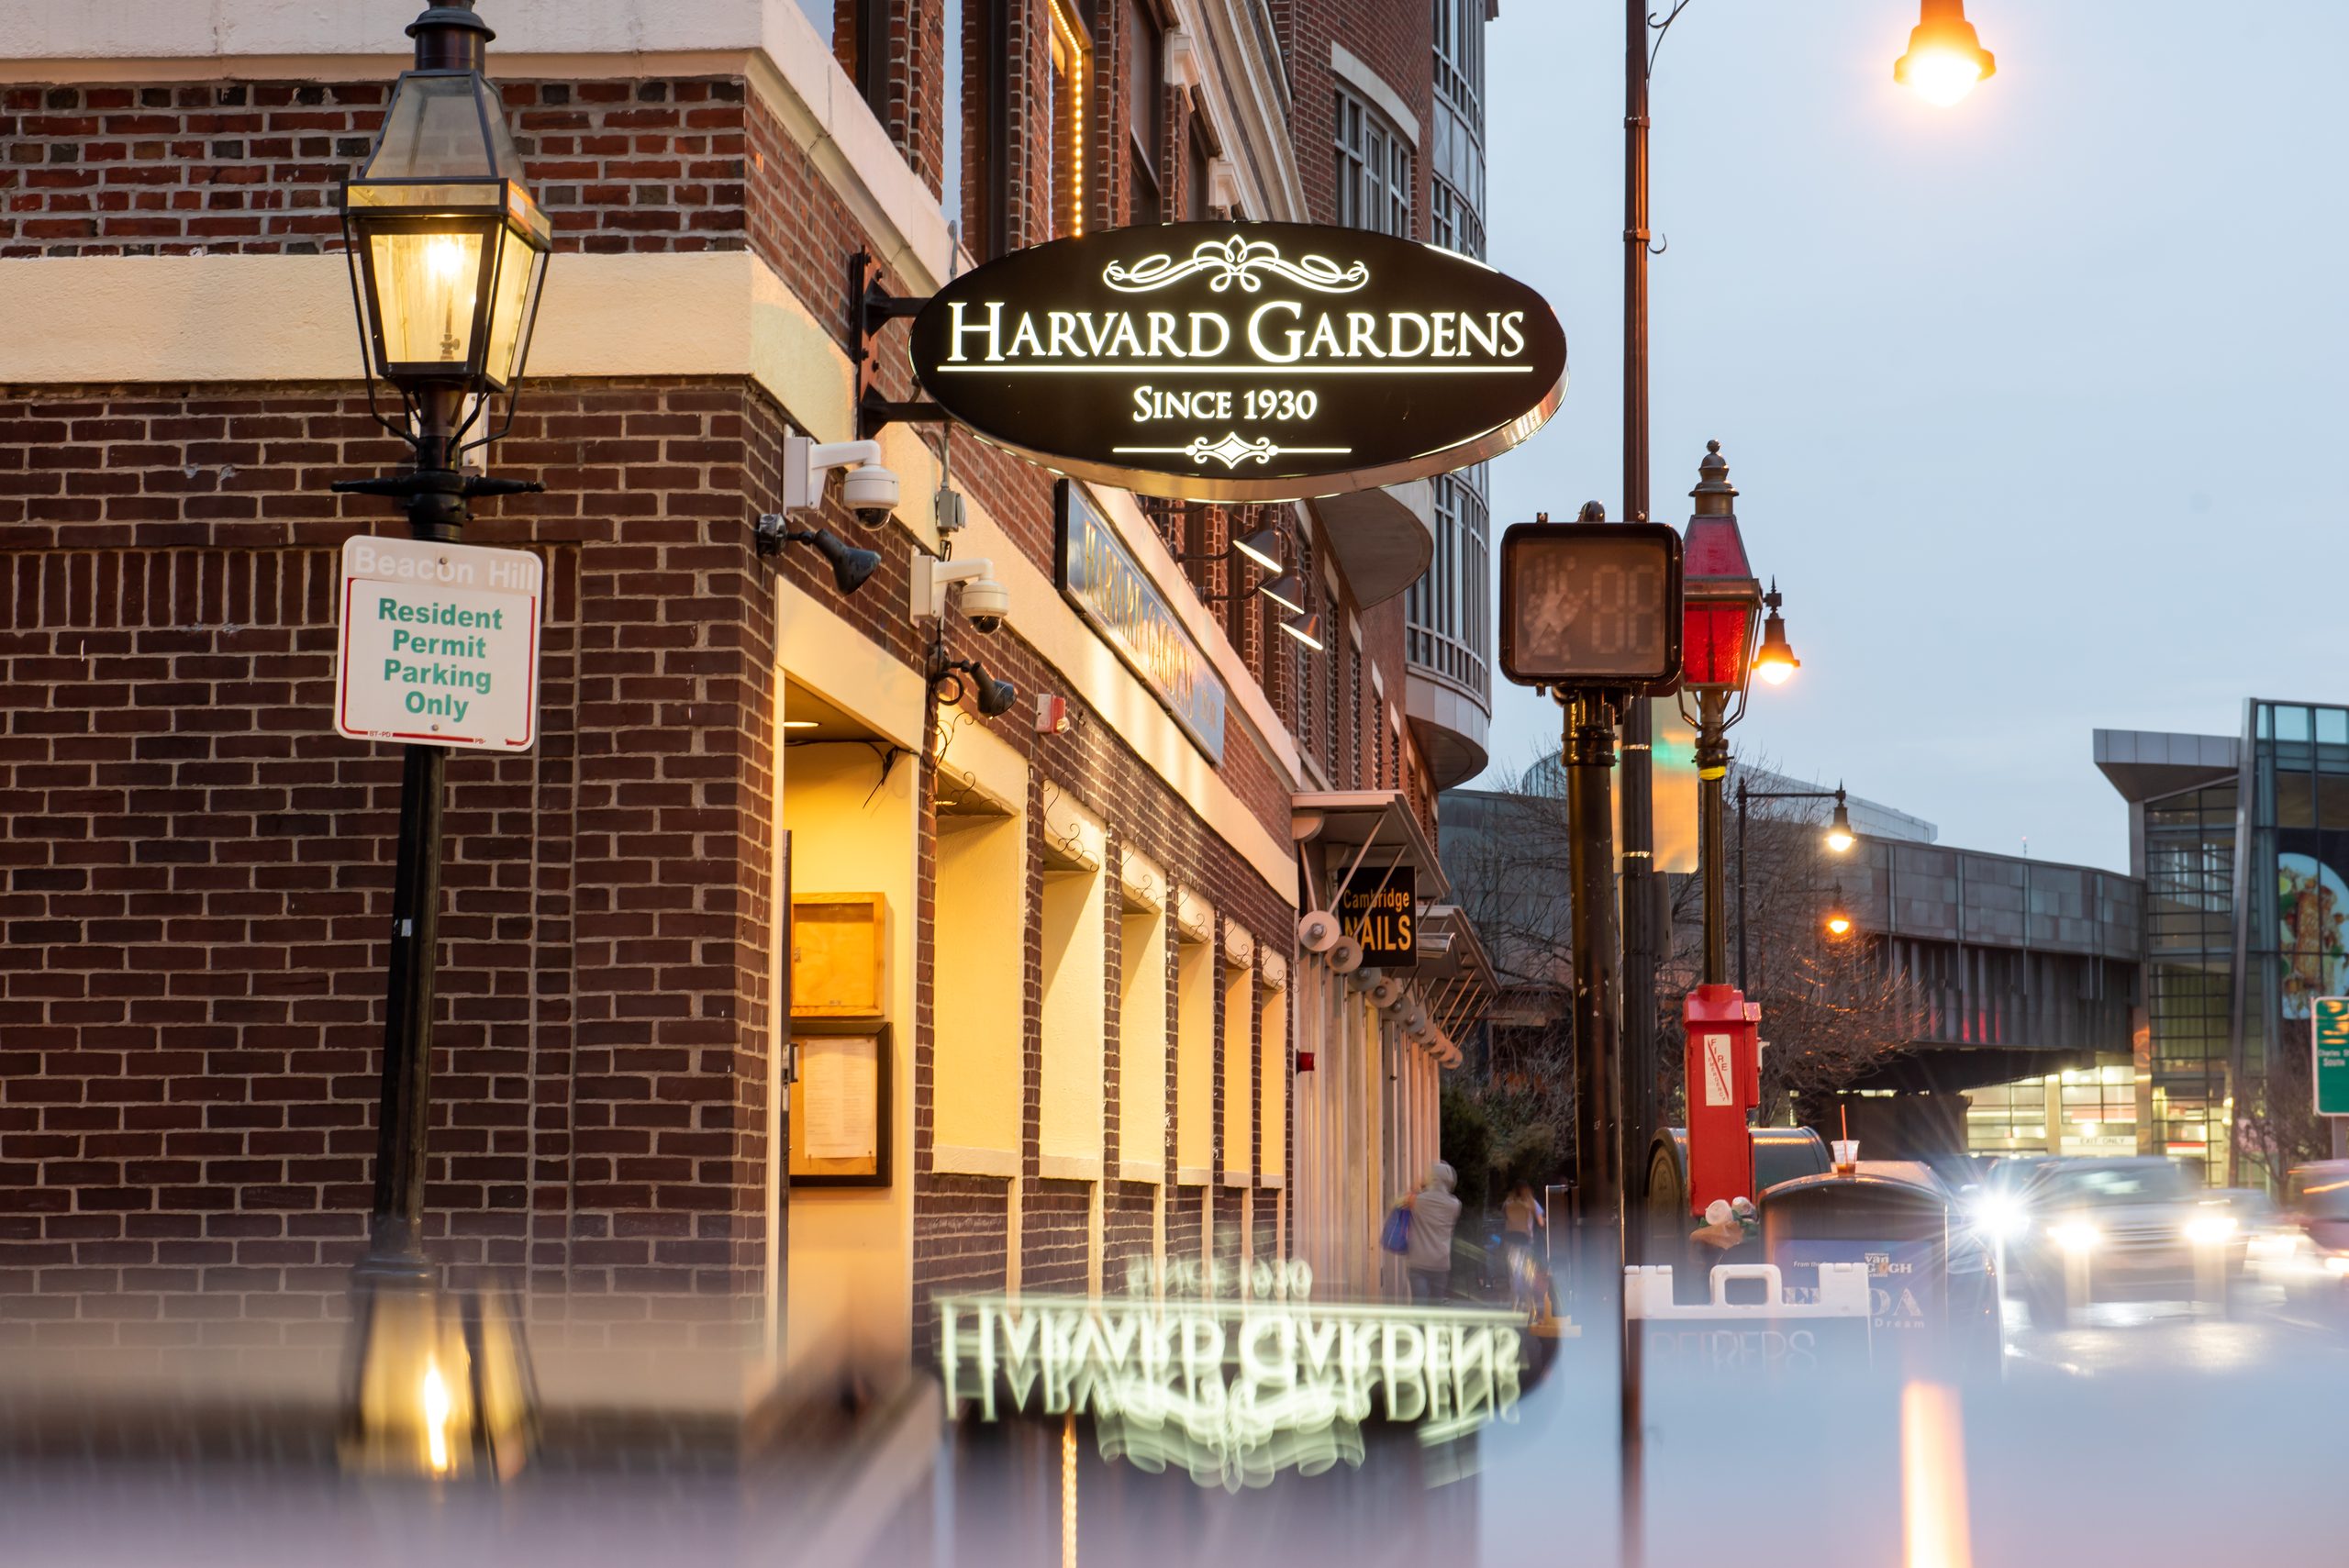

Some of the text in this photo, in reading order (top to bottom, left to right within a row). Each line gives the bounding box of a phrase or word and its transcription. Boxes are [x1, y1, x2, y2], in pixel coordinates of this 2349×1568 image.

[947, 300, 1525, 363] HARVARD GARDENS
[1132, 386, 1318, 422] SINCE 1930
[354, 547, 534, 591] Beacon Hill
[378, 598, 504, 630] Resident
[393, 629, 487, 659] Permit
[384, 659, 492, 695] Parking
[405, 691, 470, 723] Only
[1343, 887, 1409, 913] Cambridge
[1344, 915, 1411, 951] NAILS
[1710, 1038, 1728, 1072] FIRE
[2079, 1137, 2125, 1145] EXIT ONLY
[1874, 1318, 1925, 1329] Dream
